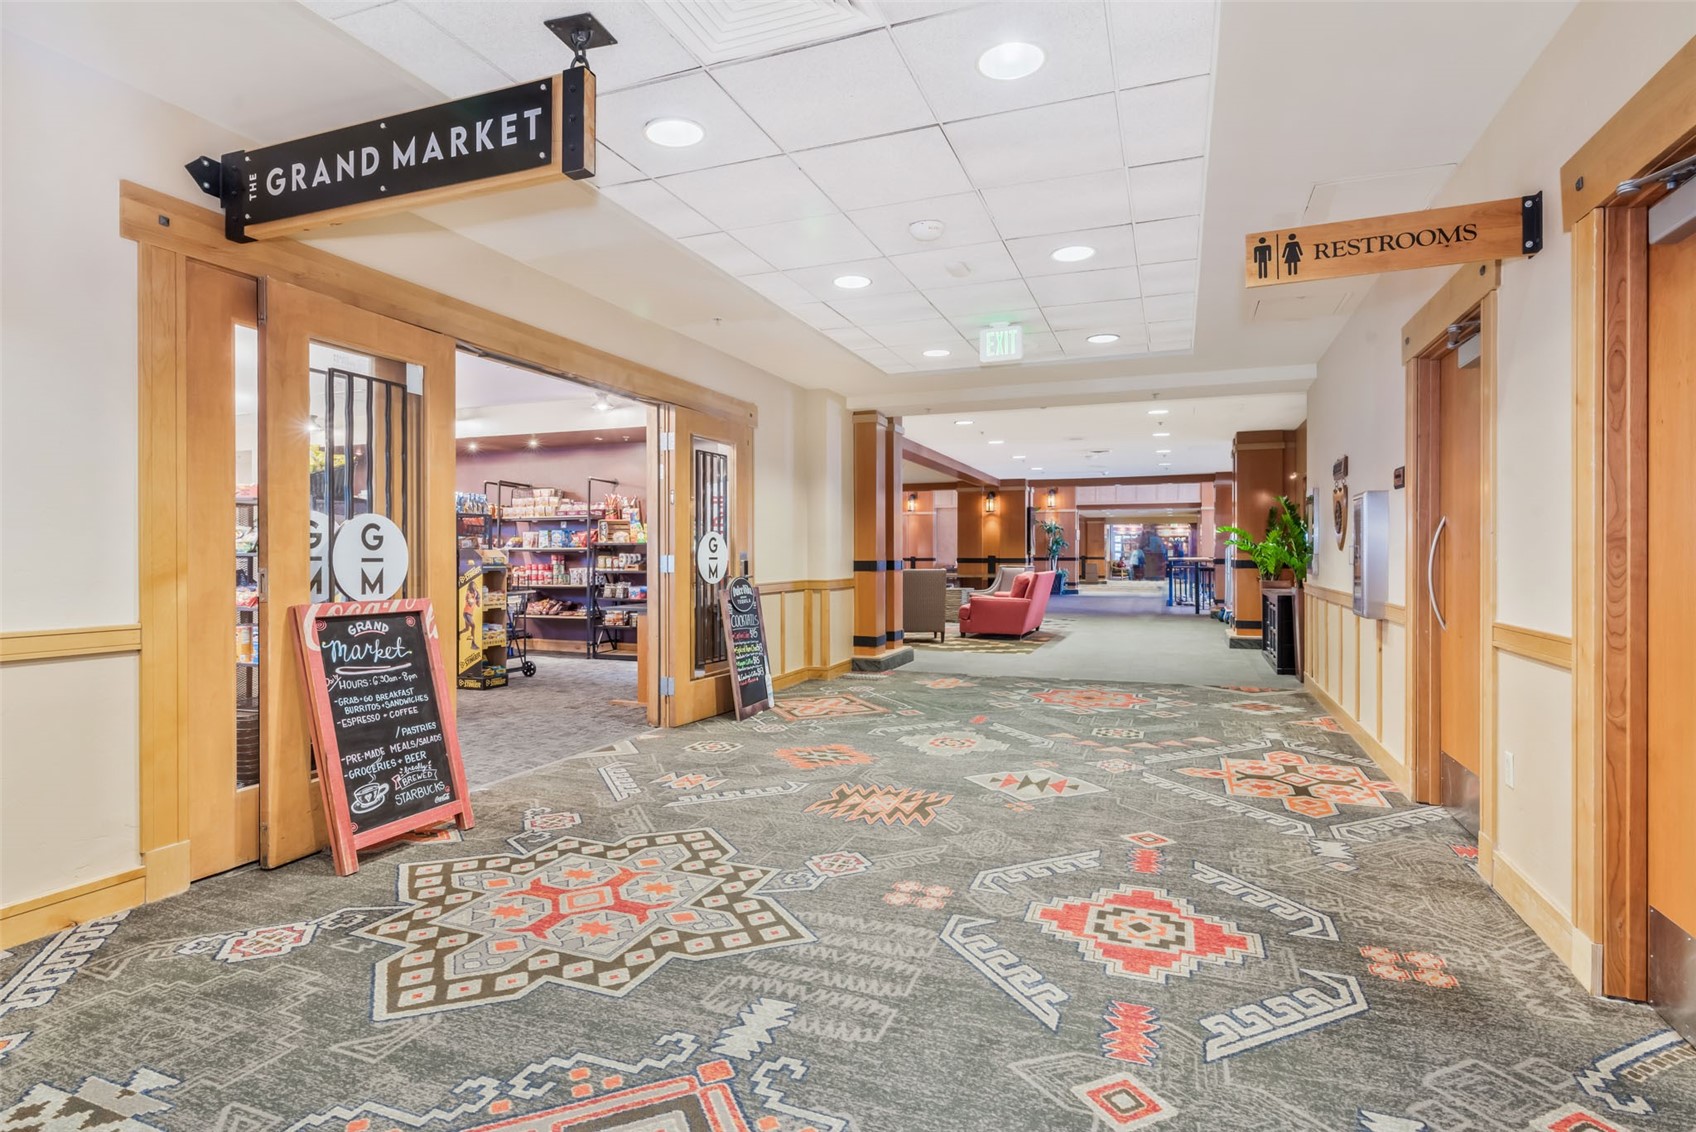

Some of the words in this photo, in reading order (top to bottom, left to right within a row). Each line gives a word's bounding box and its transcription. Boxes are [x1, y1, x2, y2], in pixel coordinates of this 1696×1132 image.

[249, 172, 257, 201] THE
[266, 146, 380, 196] GRAND
[392, 107, 542, 170] MARKET
[1313, 223, 1478, 260] RESTROOMS
[986, 329, 1018, 357] EXIT
[361, 523, 384, 551] G
[708, 537, 718, 553] G
[361, 567, 384, 595] M
[708, 563, 718, 579] M
[348, 621, 389, 635] GRAND
[322, 636, 412, 663] Market
[375, 687, 414, 701] BREAKFAST
[389, 706, 419, 719] COFFEE
[404, 750, 427, 764] BEER
[401, 771, 433, 787] BREWED
[394, 781, 445, 806] STARBUCKS
